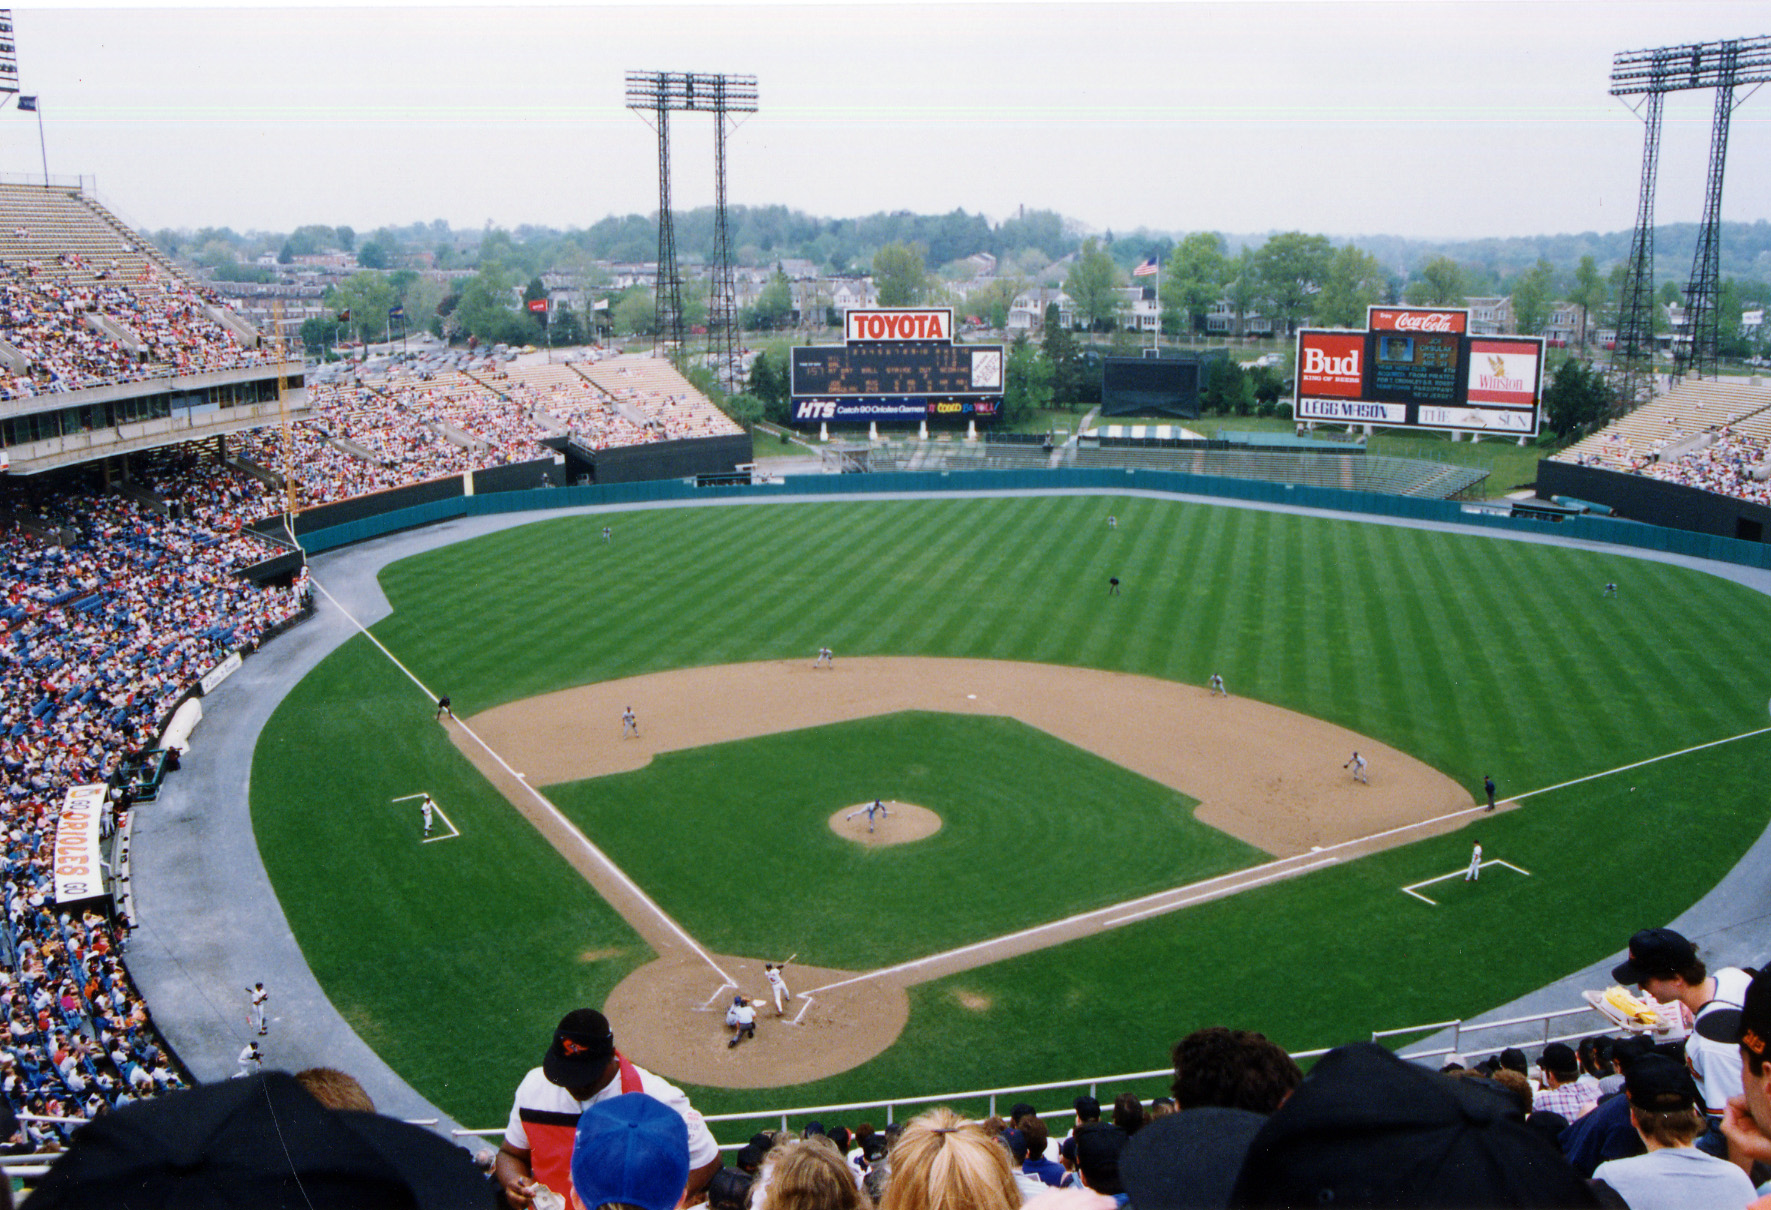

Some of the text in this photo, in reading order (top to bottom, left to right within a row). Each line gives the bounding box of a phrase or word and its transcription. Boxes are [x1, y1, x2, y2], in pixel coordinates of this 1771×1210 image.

[854, 314, 943, 339] TOYOTA
[1394, 312, 1454, 331] Coca-Cola
[1303, 347, 1359, 376] Bud
[1479, 374, 1523, 391] Winston
[796, 401, 837, 419] HTS
[837, 404, 925, 414] Catch 90 Orioles Games
[1305, 400, 1338, 416] LEGG
[1341, 402, 1387, 419] MASON
[1423, 409, 1528, 428] THE SUN
[56, 799, 91, 895] GO ORIOLES GO
